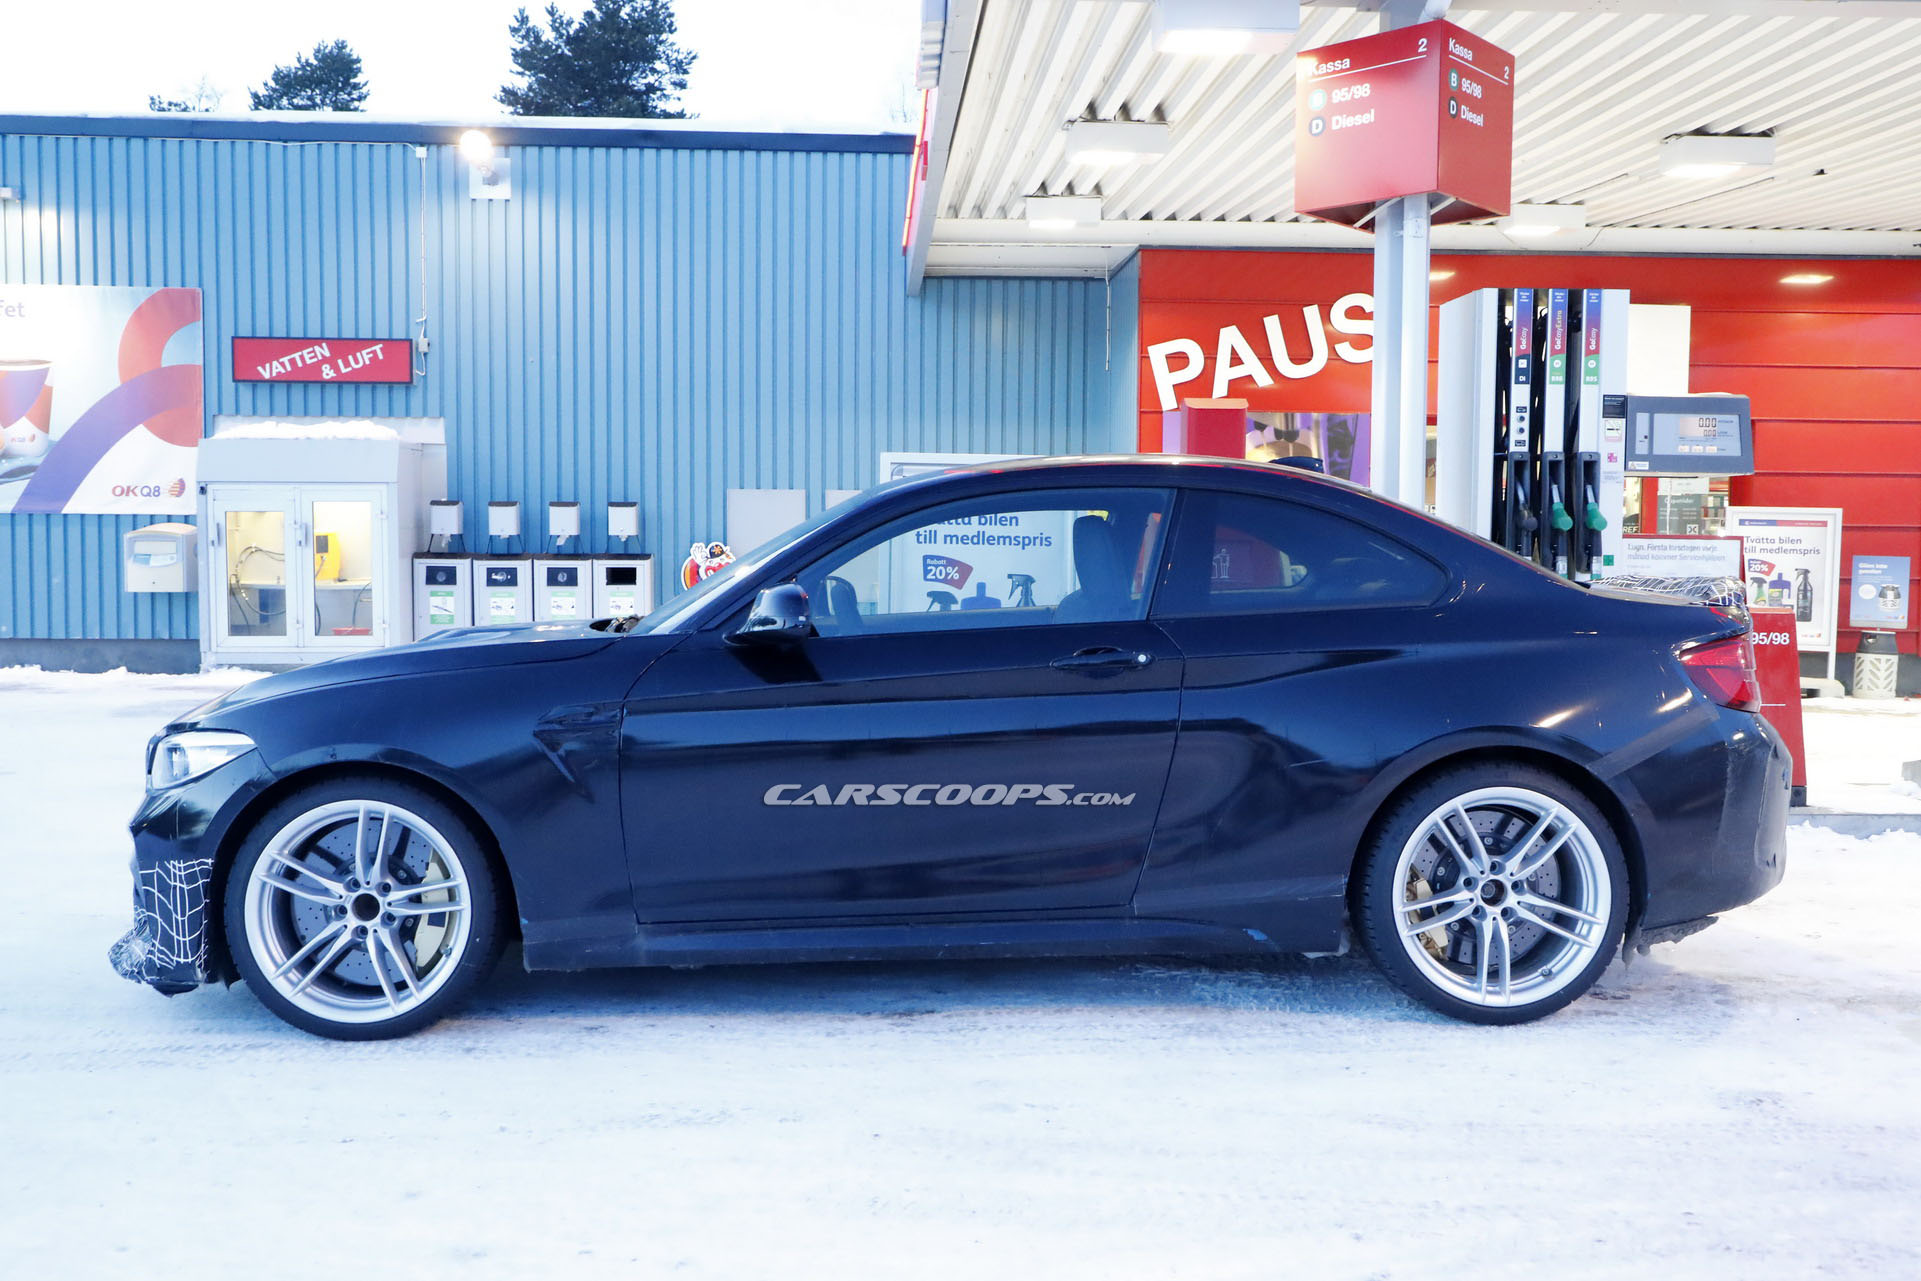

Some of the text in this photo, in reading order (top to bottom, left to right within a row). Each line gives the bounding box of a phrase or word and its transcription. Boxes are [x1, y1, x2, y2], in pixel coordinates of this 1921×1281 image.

[1308, 38, 1427, 77] Kassa 2
[1449, 38, 1509, 79] Kassa 2
[1332, 84, 1370, 103] 95/98
[1451, 73, 1482, 98] B 95/98
[1311, 109, 1374, 134] D Diesel
[1450, 101, 1484, 126] D Diesel
[256, 342, 331, 379] VATTEN
[321, 344, 383, 379] & LUFT
[1147, 292, 1375, 412] PAUS
[978, 512, 1019, 526] bilen
[915, 530, 1052, 550] till medlemspris
[1744, 546, 1821, 556] till medlemspris
[1745, 536, 1802, 545] Tvätta bilen
[926, 566, 959, 580] 20%
[1750, 564, 1768, 572] 20%
[1752, 632, 1790, 645] 95/98
